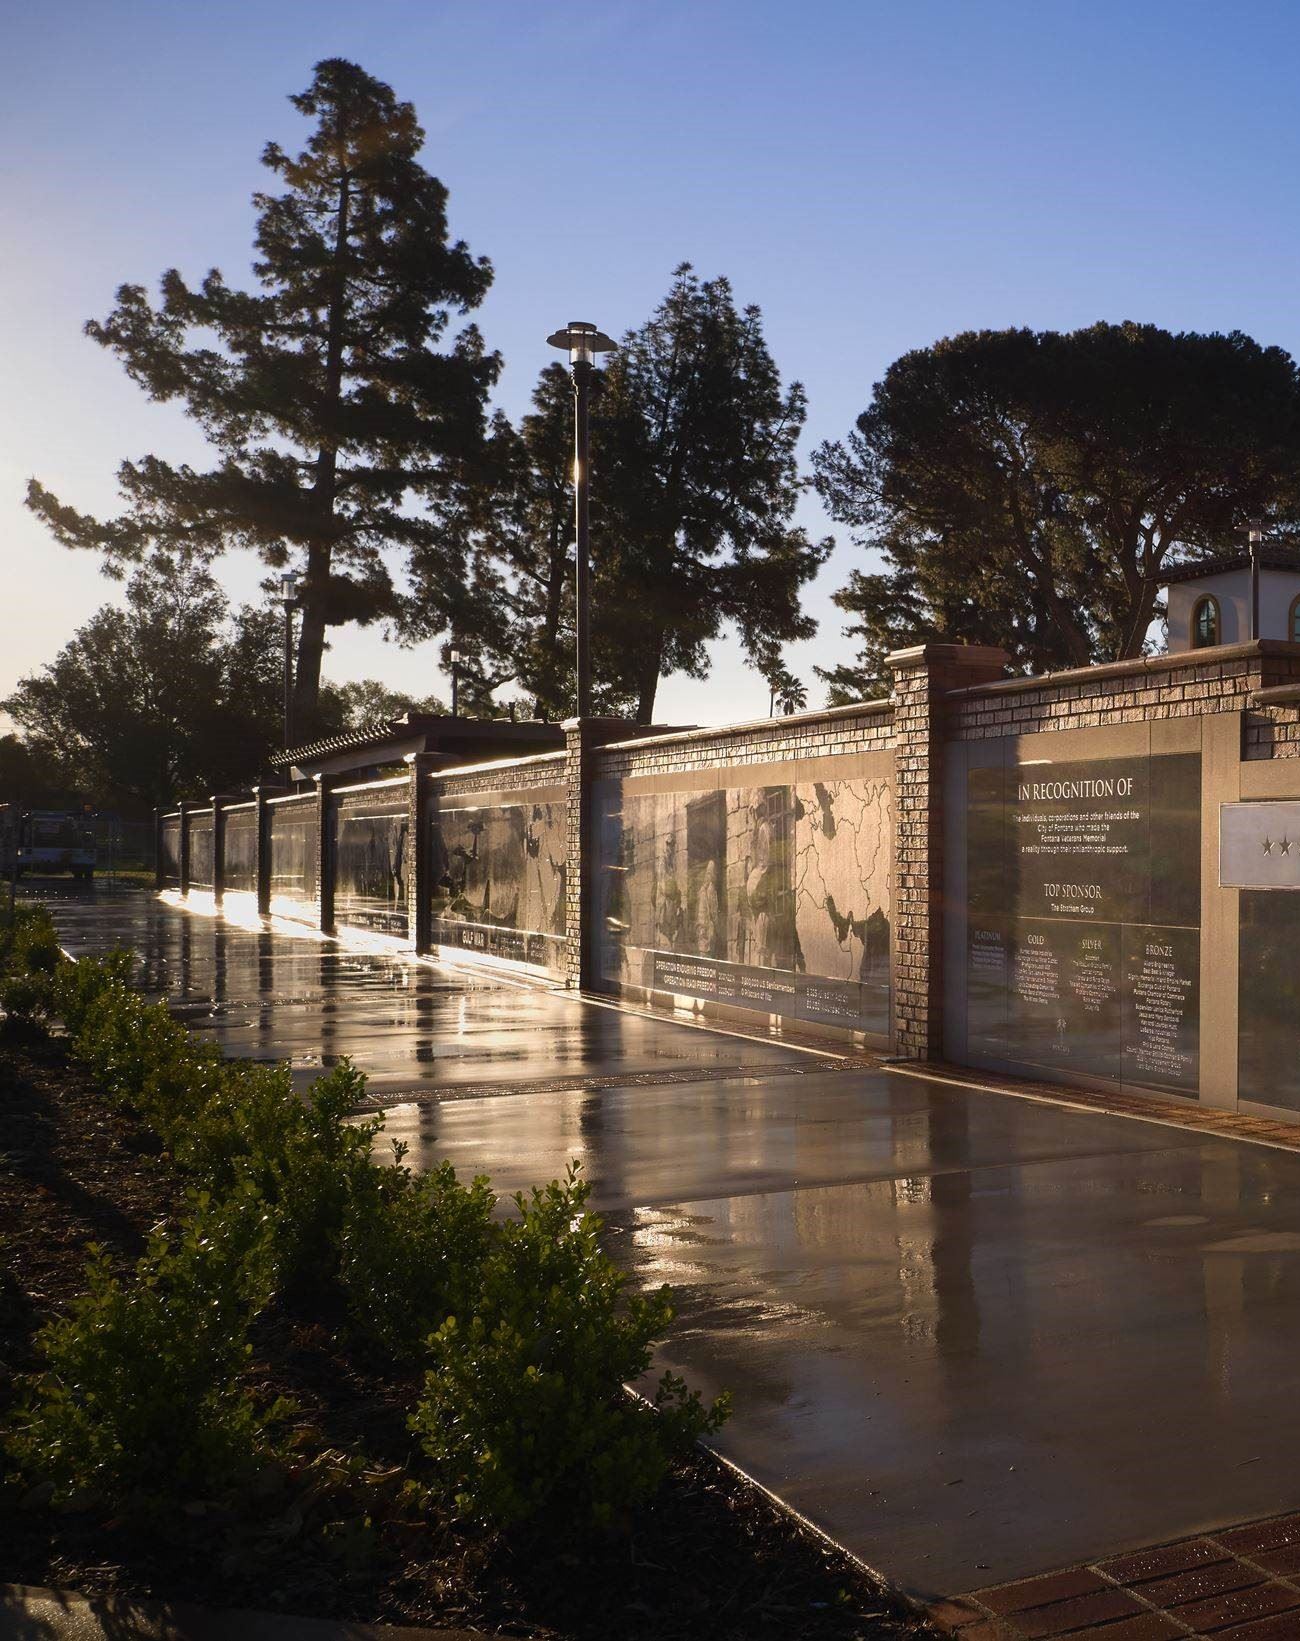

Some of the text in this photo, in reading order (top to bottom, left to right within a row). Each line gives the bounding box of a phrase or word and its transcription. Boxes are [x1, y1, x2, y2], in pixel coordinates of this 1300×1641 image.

[1018, 778, 1133, 800] IN RECOGNITION OF
[1049, 813, 1078, 823] corporations
[1080, 812, 1089, 820] and
[1090, 812, 1103, 820] other
[1104, 811, 1122, 820] friends
[1124, 811, 1129, 820] of
[1130, 811, 1140, 819] the
[1038, 824, 1047, 833] City
[1055, 824, 1073, 832] Fontana
[1087, 823, 1100, 831] made
[1101, 823, 1109, 831] the
[1041, 835, 1060, 843] Fontana
[1083, 833, 1106, 842] Memorial
[1026, 845, 1040, 854] reality
[1041, 845, 1059, 854] through
[1073, 845, 1105, 854] philanthropic
[1044, 884, 1102, 898] TOP SPONSOR
[1051, 903, 1059, 911] The
[1080, 904, 1094, 914] Group
[1028, 934, 1044, 945] GOLD
[1082, 939, 1102, 950] SILVER
[1145, 944, 1173, 957] BRONZE
[677, 963, 696, 975] ENDURING
[697, 966, 717, 978] FREEDOM
